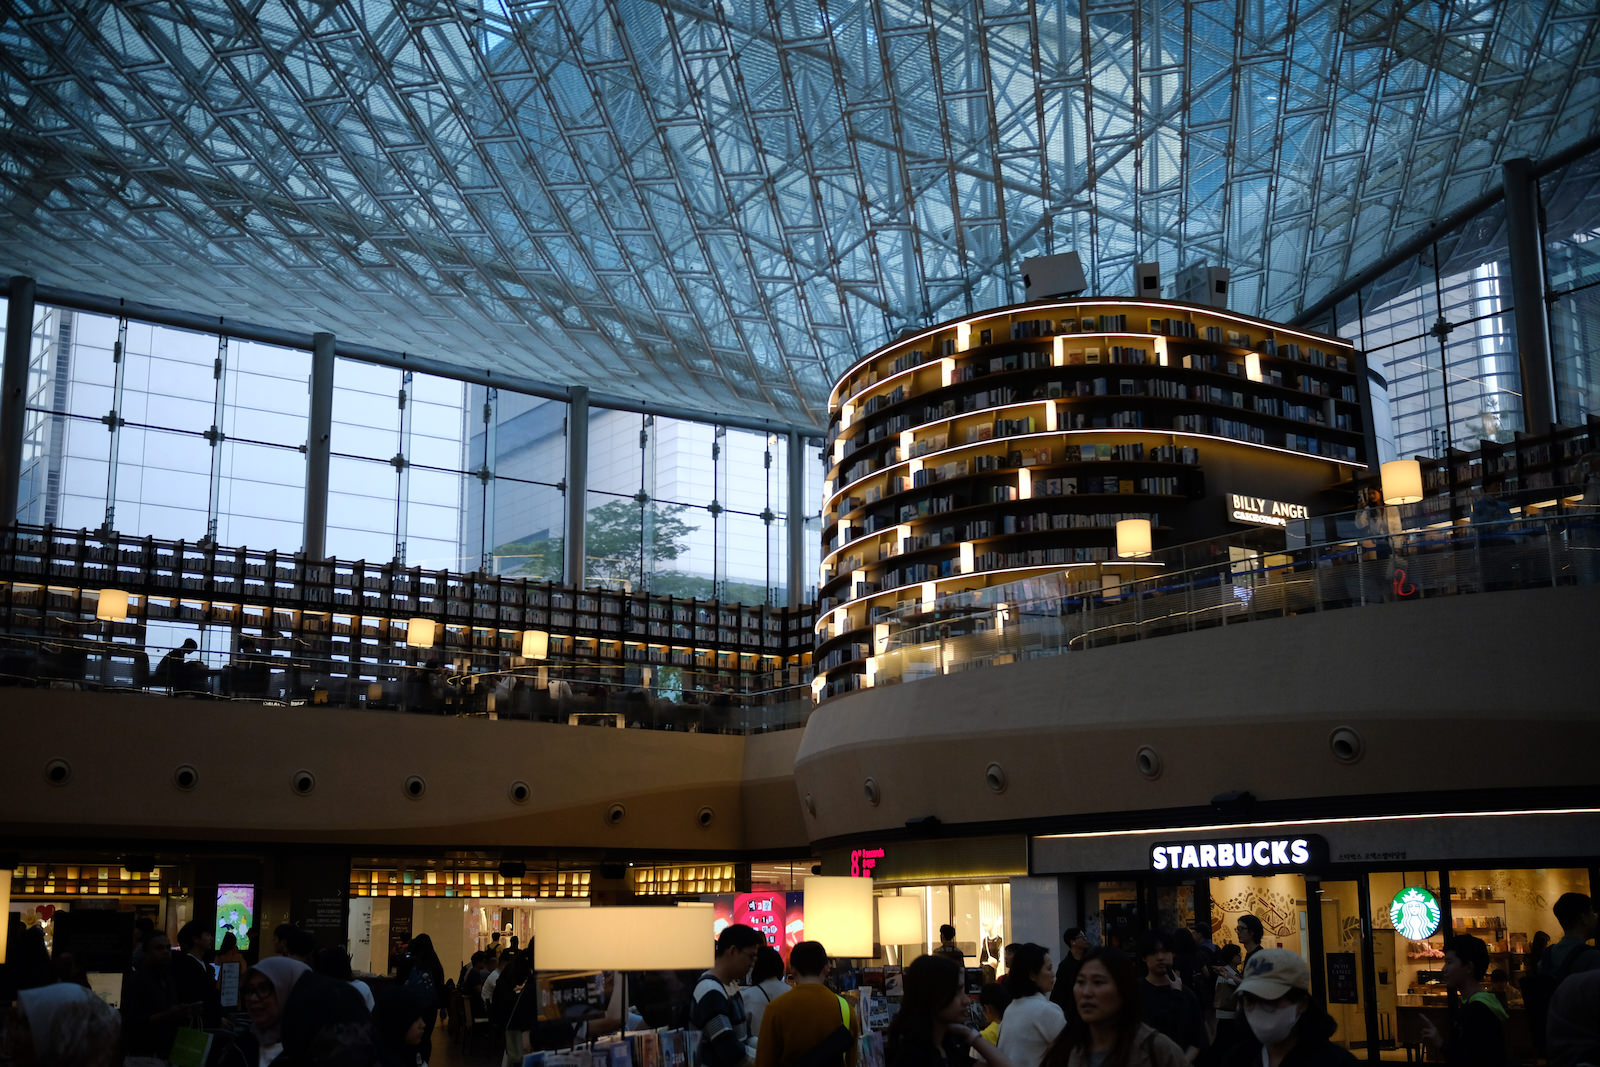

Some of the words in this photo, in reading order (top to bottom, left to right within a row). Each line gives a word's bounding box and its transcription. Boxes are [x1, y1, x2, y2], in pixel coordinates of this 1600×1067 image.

[1232, 494, 1265, 513] BILLY
[1272, 501, 1310, 520] ANGEL
[1152, 839, 1310, 870] STARBUCKS
